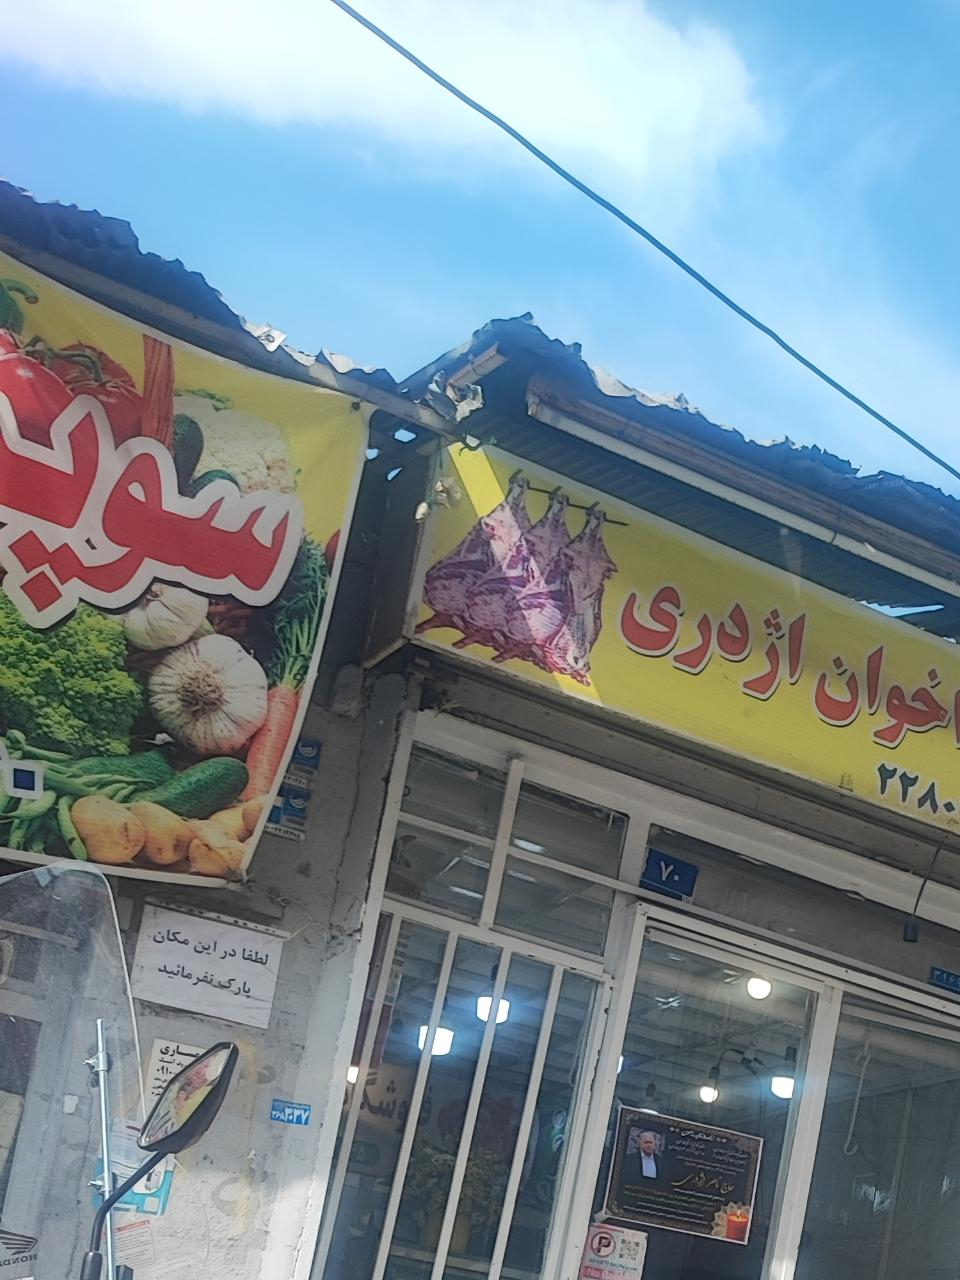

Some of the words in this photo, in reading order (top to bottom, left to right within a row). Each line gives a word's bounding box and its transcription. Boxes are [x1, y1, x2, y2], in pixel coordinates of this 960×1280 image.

[620, 586, 806, 697] اژدری
[660, 861, 680, 881] ۷۰
[153, 929, 190, 946] مکان
[194, 942, 218, 955] این
[220, 949, 237, 959] در
[242, 948, 268, 965] لطفا
[218, 978, 251, 999] پارک
